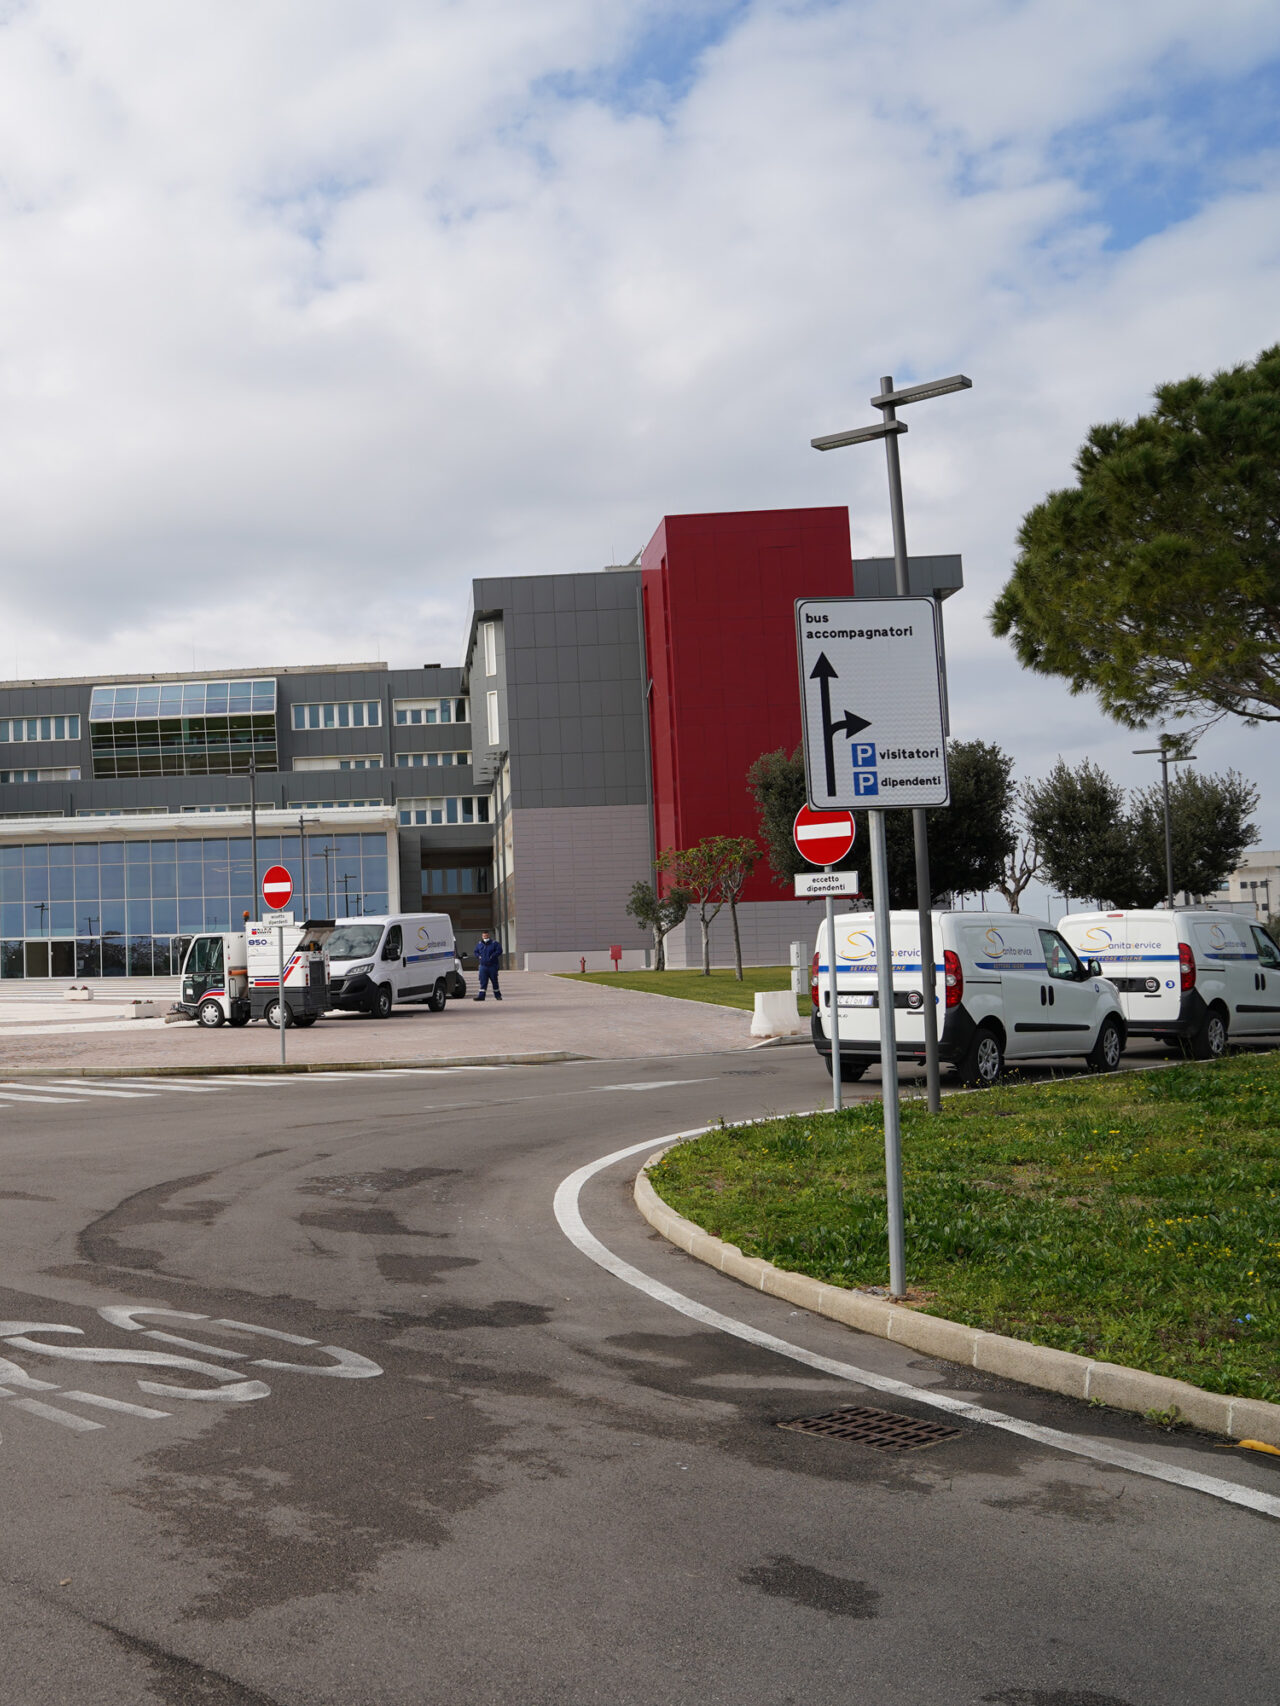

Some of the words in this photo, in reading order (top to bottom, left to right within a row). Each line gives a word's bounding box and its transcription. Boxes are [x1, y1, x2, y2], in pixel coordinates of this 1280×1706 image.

[805, 613, 829, 623] bus
[806, 626, 913, 640] accompagnatori
[856, 745, 873, 766] P
[879, 748, 939, 760] visitatori
[858, 773, 875, 794] P
[881, 776, 941, 788] dipendenti
[806, 884, 846, 892] dipendenti
